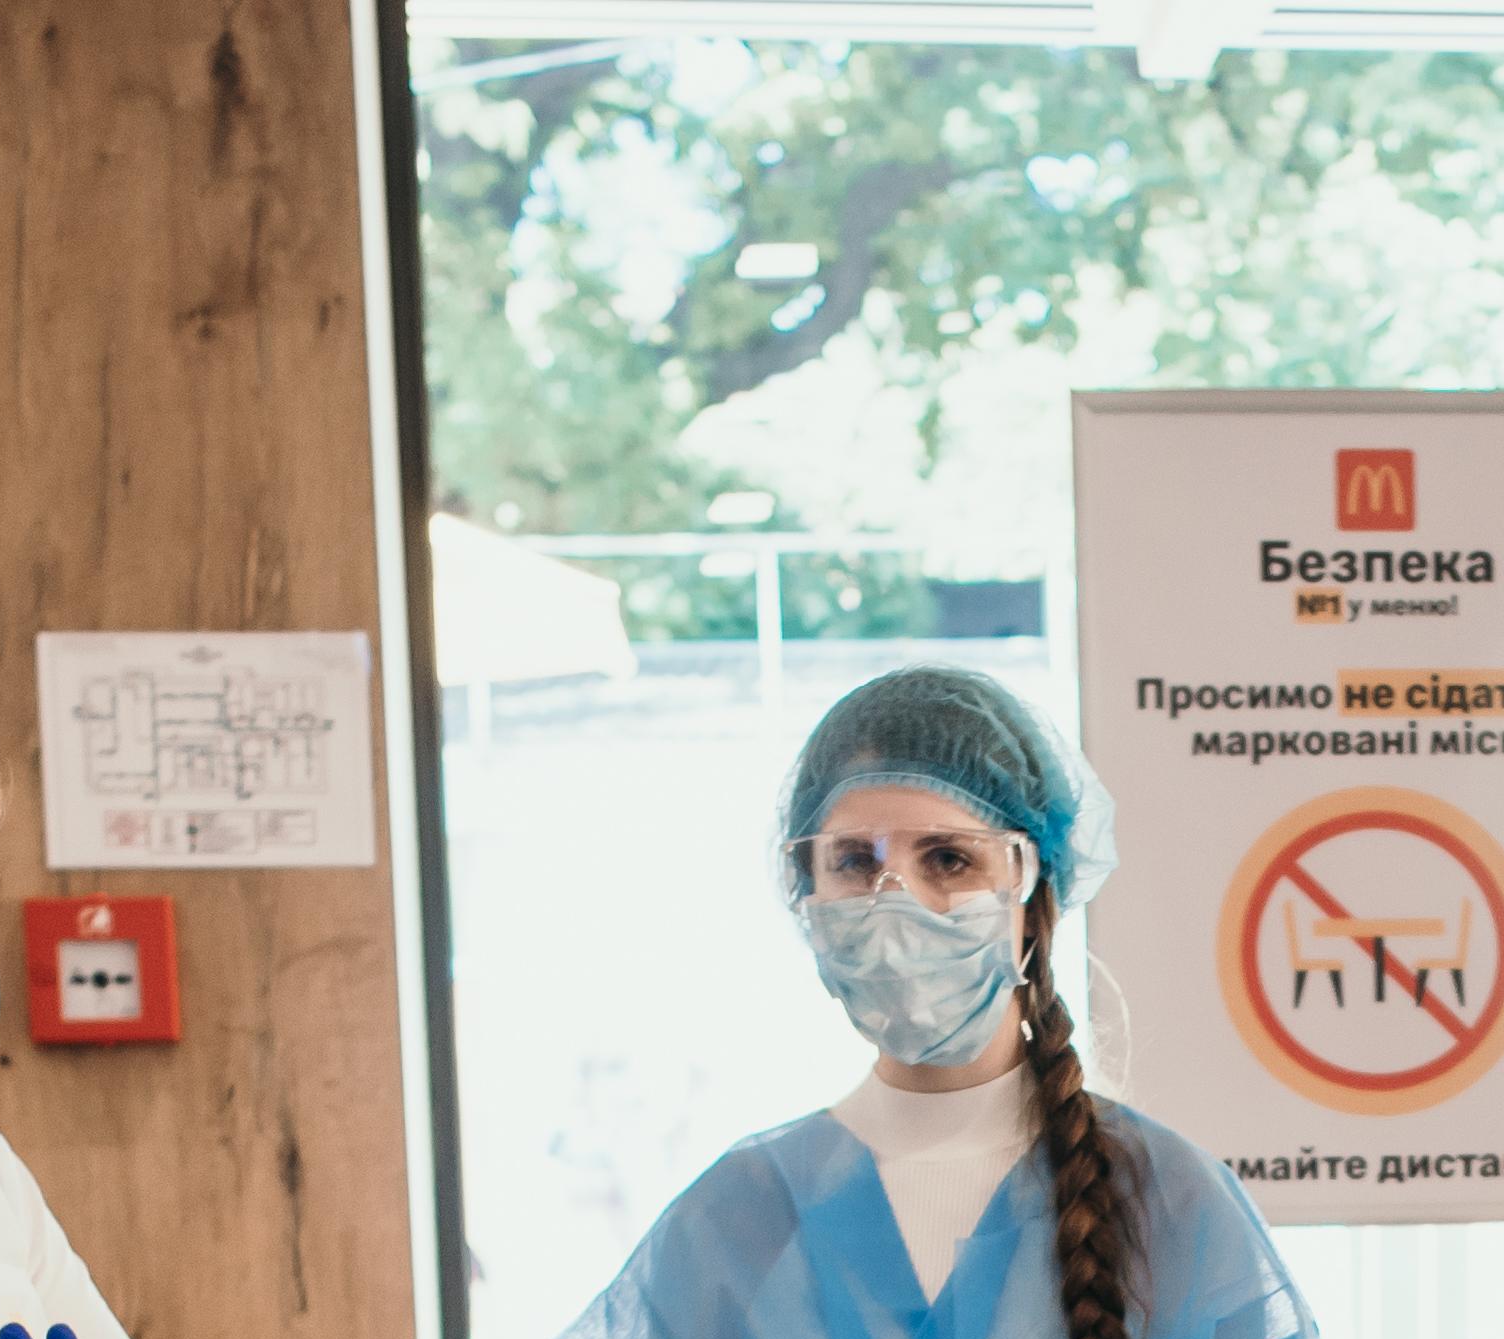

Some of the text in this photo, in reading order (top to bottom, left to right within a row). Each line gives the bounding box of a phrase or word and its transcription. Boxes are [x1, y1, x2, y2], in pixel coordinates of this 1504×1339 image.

[1259, 539, 1495, 585] Безпека
[1296, 594, 1459, 622] №1 у меню!
[1136, 677, 1334, 719] Просимо
[1343, 683, 1396, 711] не
[1191, 720, 1418, 766] марковані
